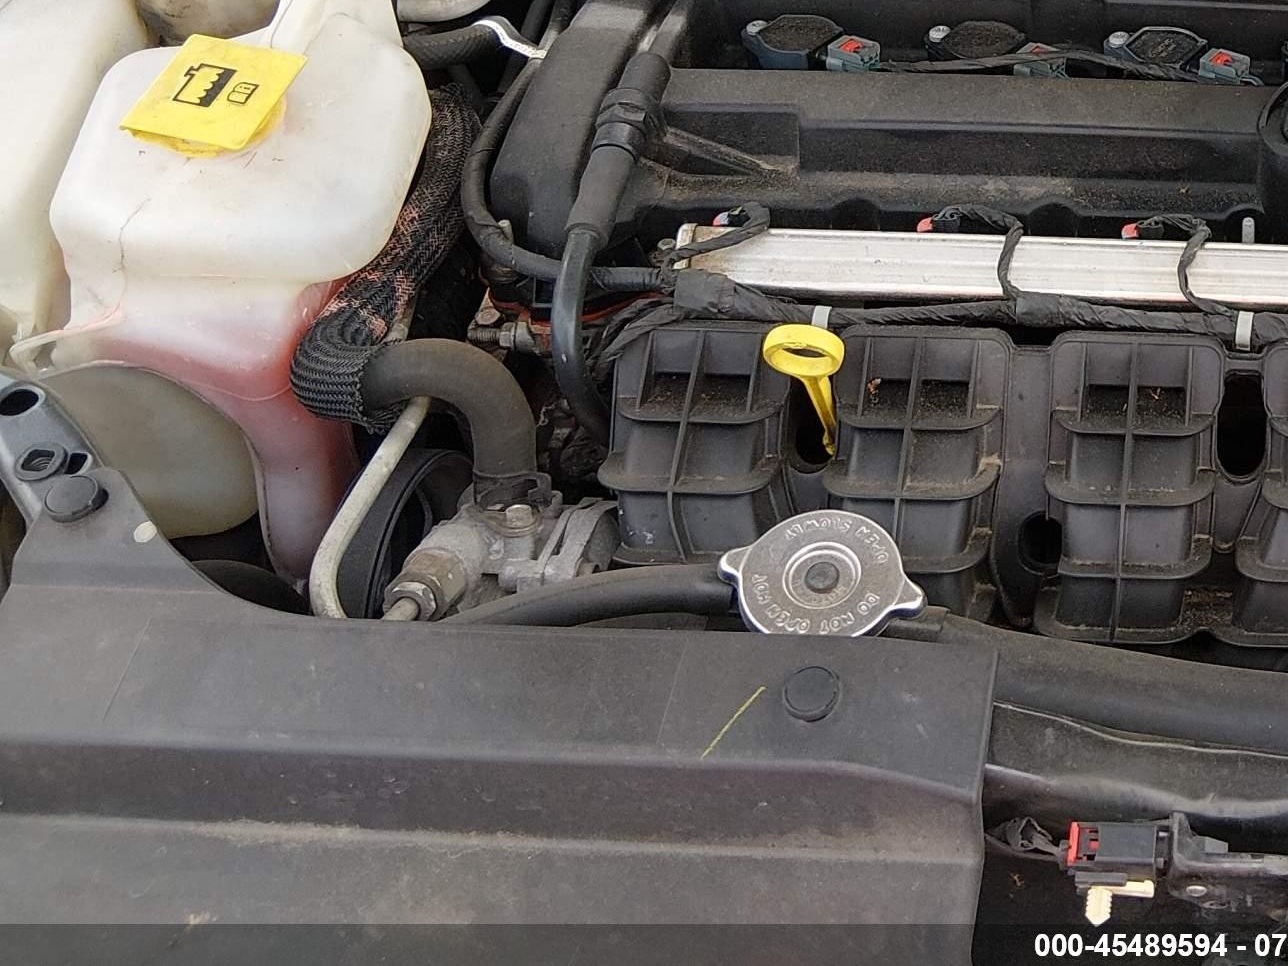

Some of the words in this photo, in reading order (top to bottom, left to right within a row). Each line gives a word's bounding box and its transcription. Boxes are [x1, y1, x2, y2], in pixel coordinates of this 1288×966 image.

[785, 516, 852, 541] SLOWLY
[855, 525, 889, 564] OPEN
[751, 574, 772, 605] HOT
[856, 592, 880, 616] DO
[766, 603, 811, 634] OPEN
[819, 612, 855, 634] NOT
